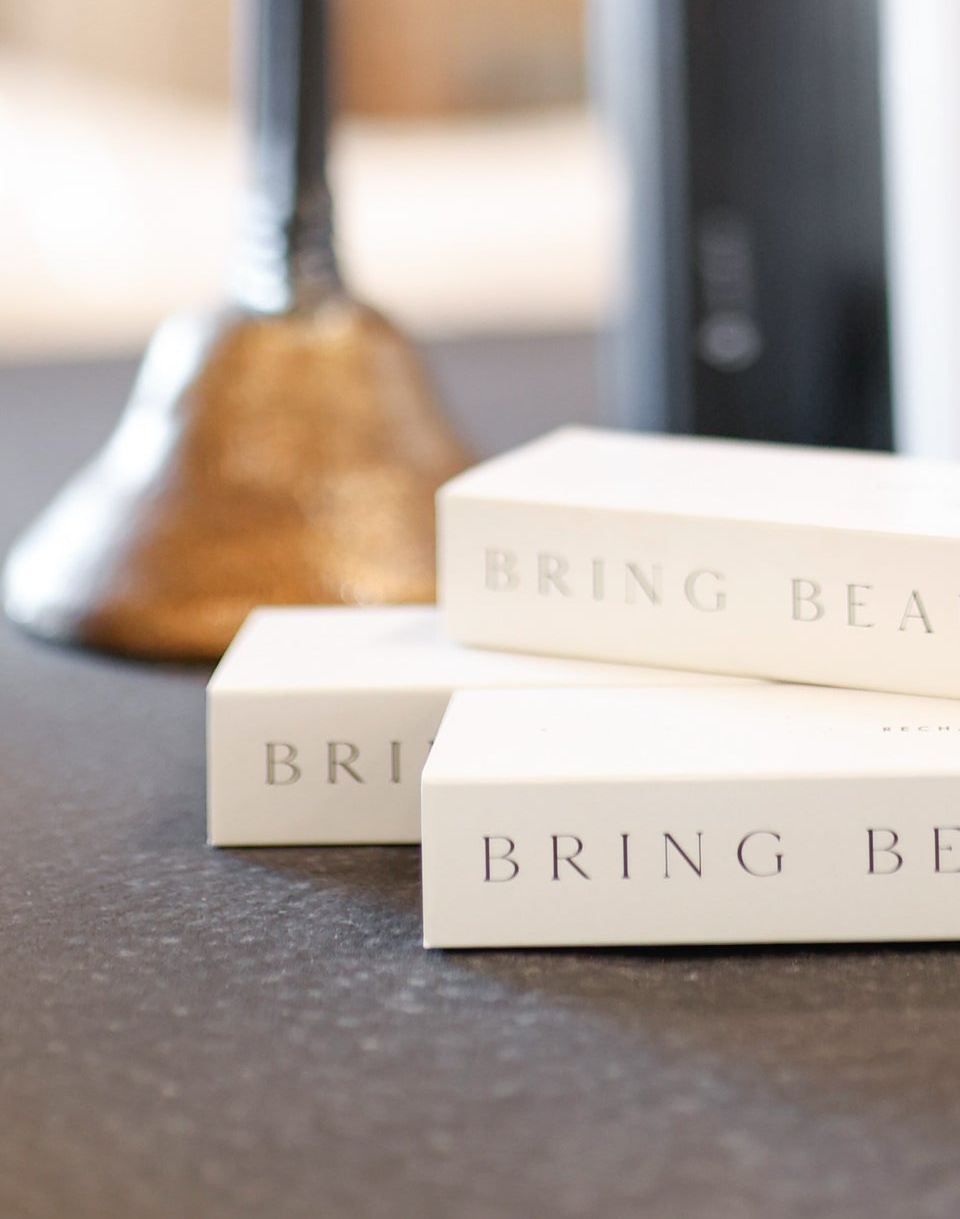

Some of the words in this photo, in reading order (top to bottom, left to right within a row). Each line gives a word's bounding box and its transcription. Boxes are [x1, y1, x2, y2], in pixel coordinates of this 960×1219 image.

[483, 546, 728, 613] BRING
[264, 740, 434, 786] BRI
[482, 828, 785, 883] BRING
